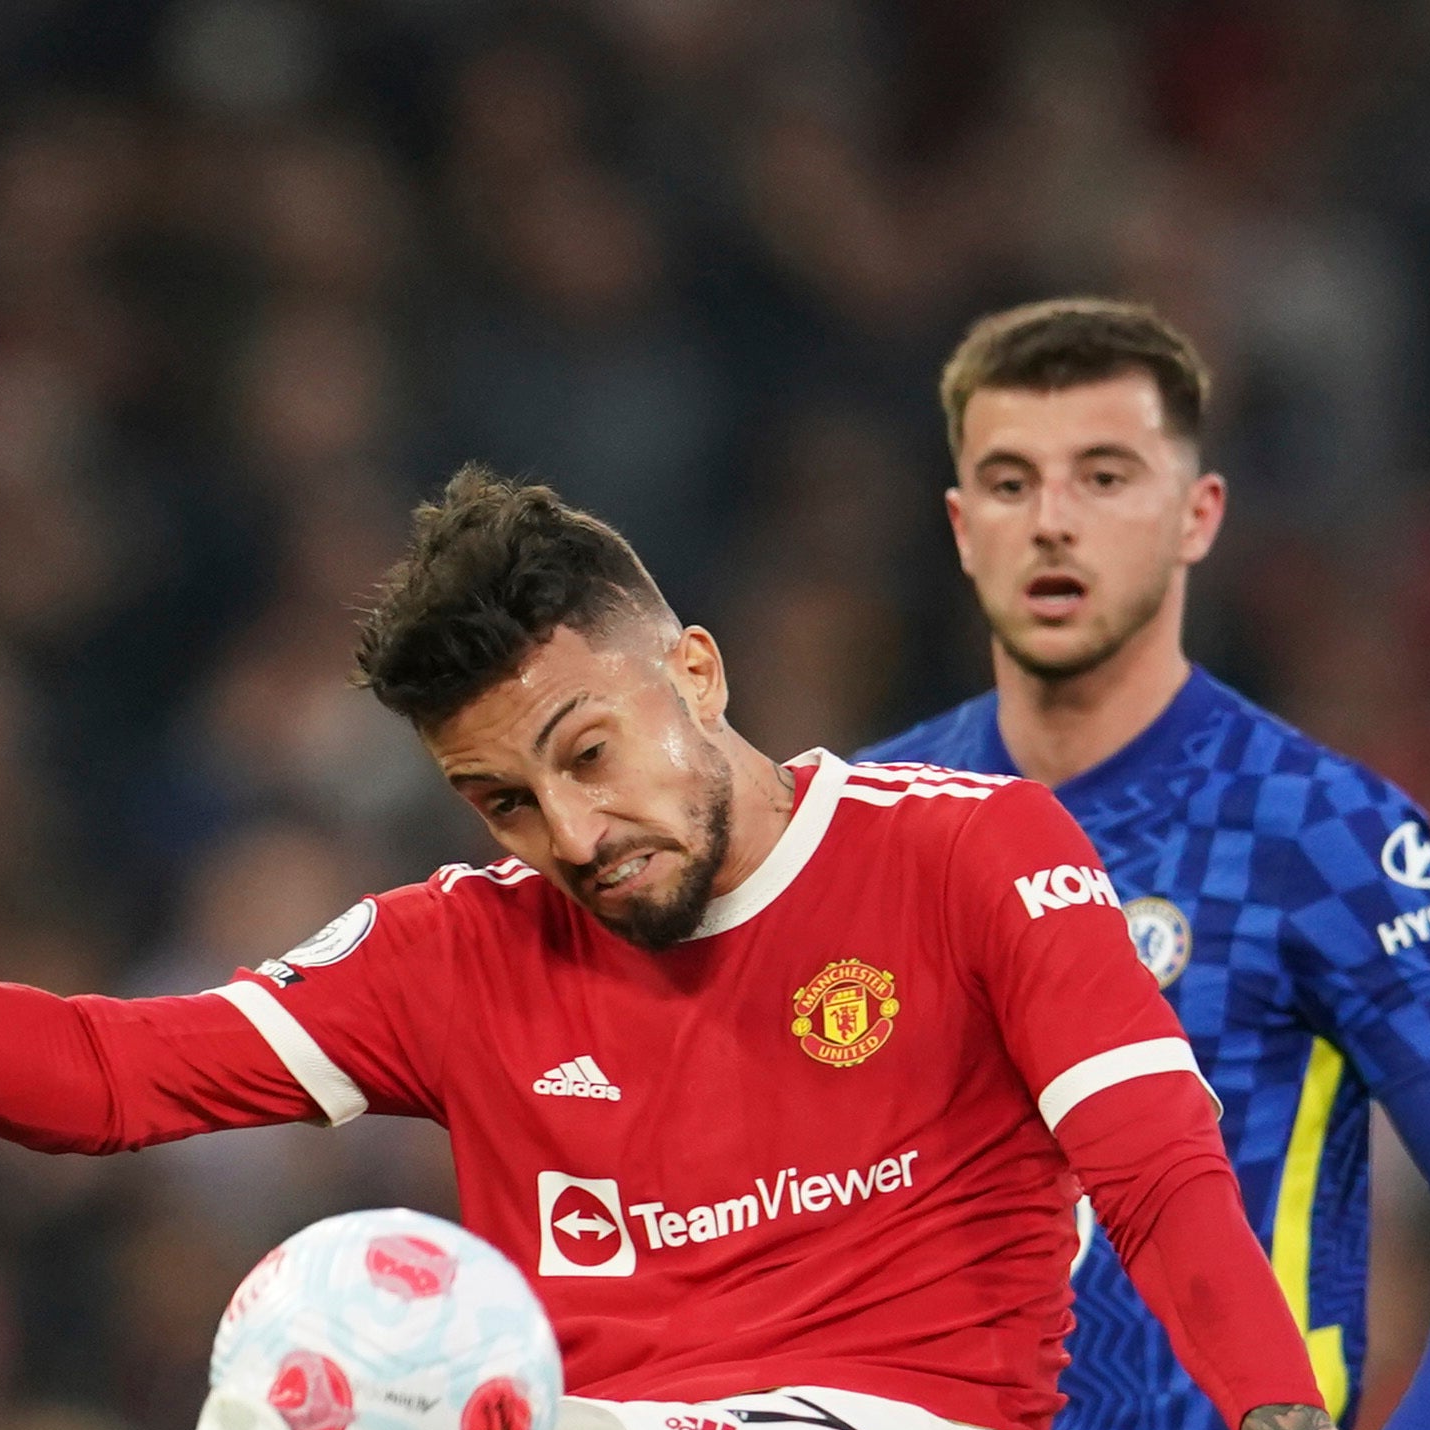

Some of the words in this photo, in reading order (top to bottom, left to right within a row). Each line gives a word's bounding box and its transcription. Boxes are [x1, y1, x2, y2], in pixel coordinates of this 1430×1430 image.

[801, 966, 888, 1009] MANCHESTER
[818, 1036, 879, 1060] UNITED
[532, 1077, 622, 1102] adidas
[629, 1150, 919, 1250] TeamViewer
